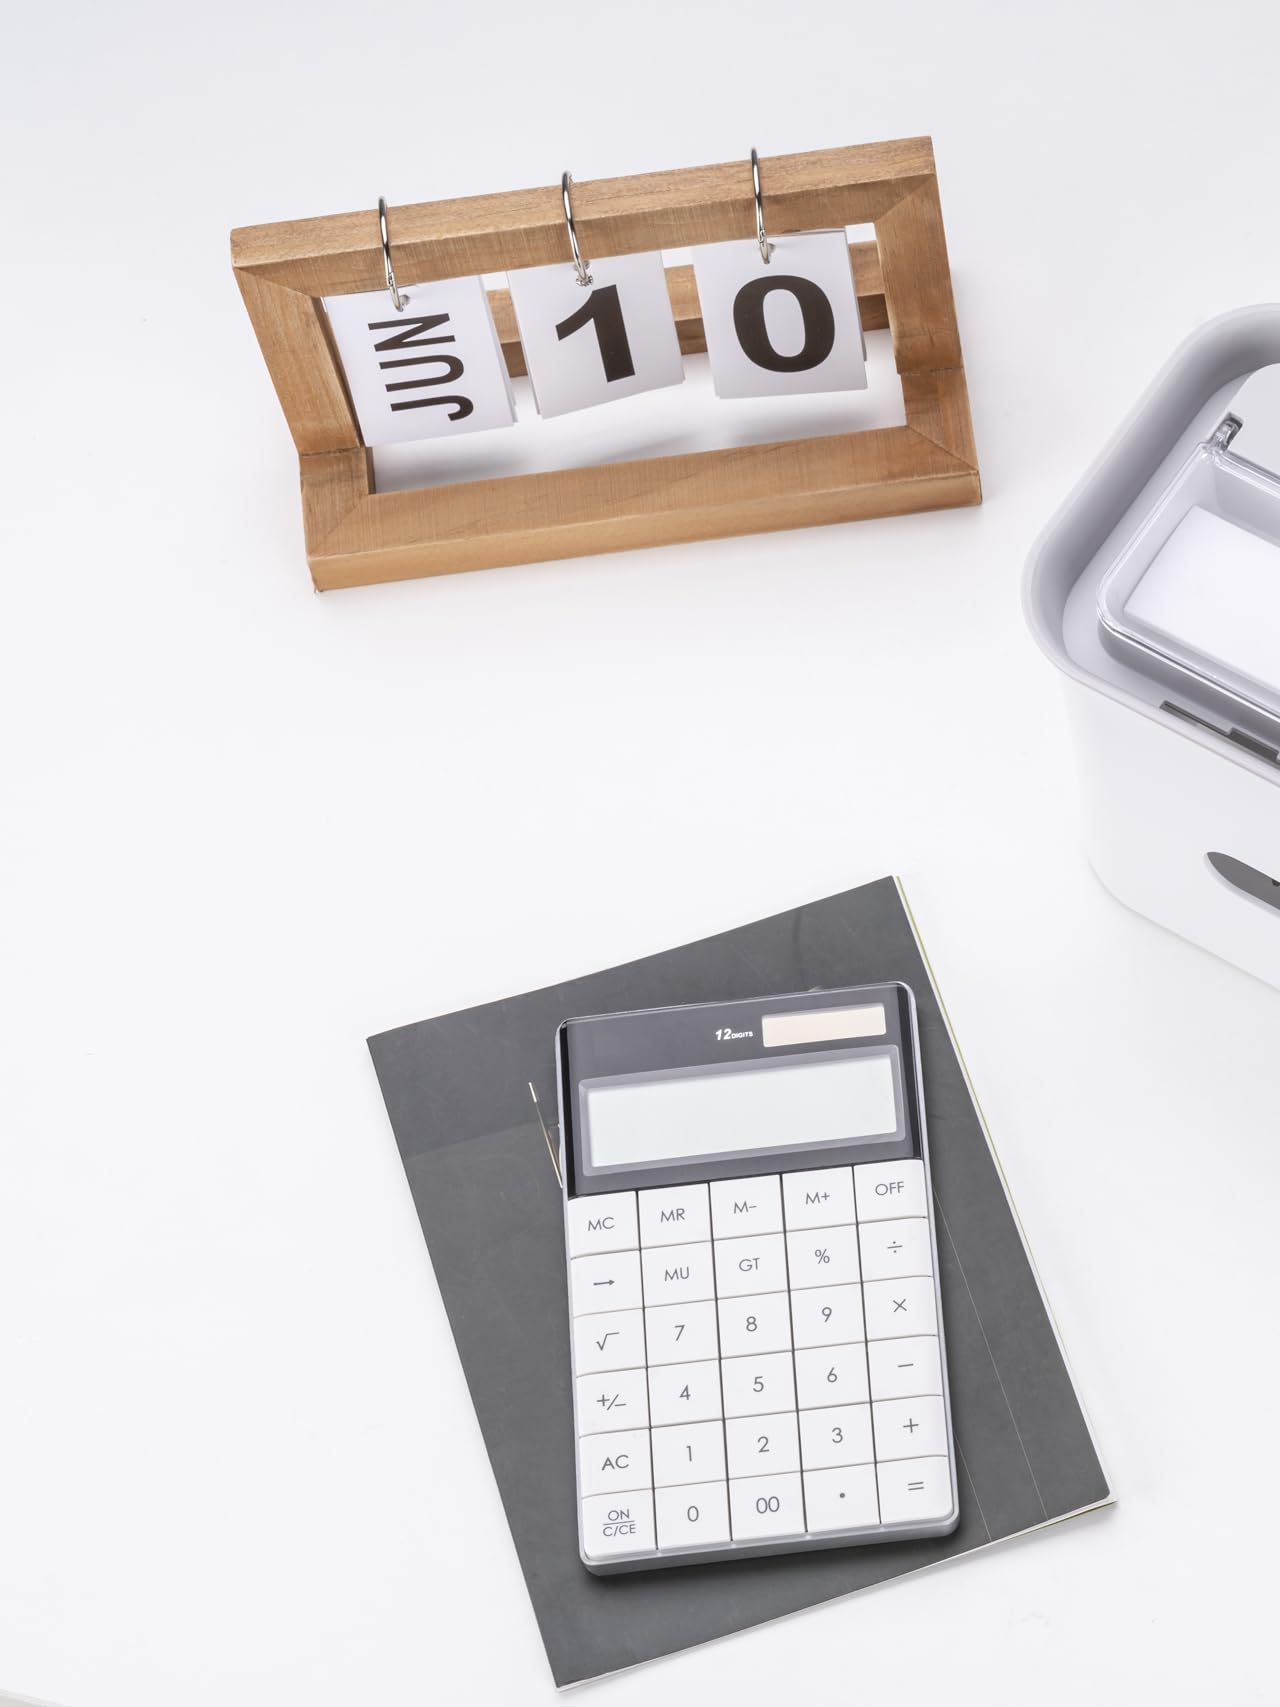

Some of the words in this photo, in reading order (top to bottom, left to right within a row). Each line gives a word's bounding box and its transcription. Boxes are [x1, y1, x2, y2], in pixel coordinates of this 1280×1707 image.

[733, 275, 835, 373] 0
[556, 285, 635, 382] 1
[368, 313, 473, 421] JUN
[875, 1182, 904, 1195] OFF
[806, 1192, 829, 1204] M+
[734, 1201, 756, 1213] M-
[661, 1208, 684, 1222] MR
[588, 1217, 614, 1231] MC
[739, 1258, 760, 1271] GT
[665, 1267, 689, 1281] MU
[822, 1307, 832, 1322] 9
[746, 1316, 757, 1332] 8
[675, 1325, 685, 1341] 7
[827, 1368, 837, 1383] 6
[753, 1376, 764, 1392] 5
[680, 1385, 690, 1400] 4
[832, 1428, 843, 1443] 3
[758, 1436, 769, 1453] 2
[602, 1455, 629, 1470] AC
[756, 1496, 779, 1514] 00
[608, 1509, 629, 1520] ON
[687, 1506, 699, 1522] 0
[603, 1525, 635, 1536] C/CE
